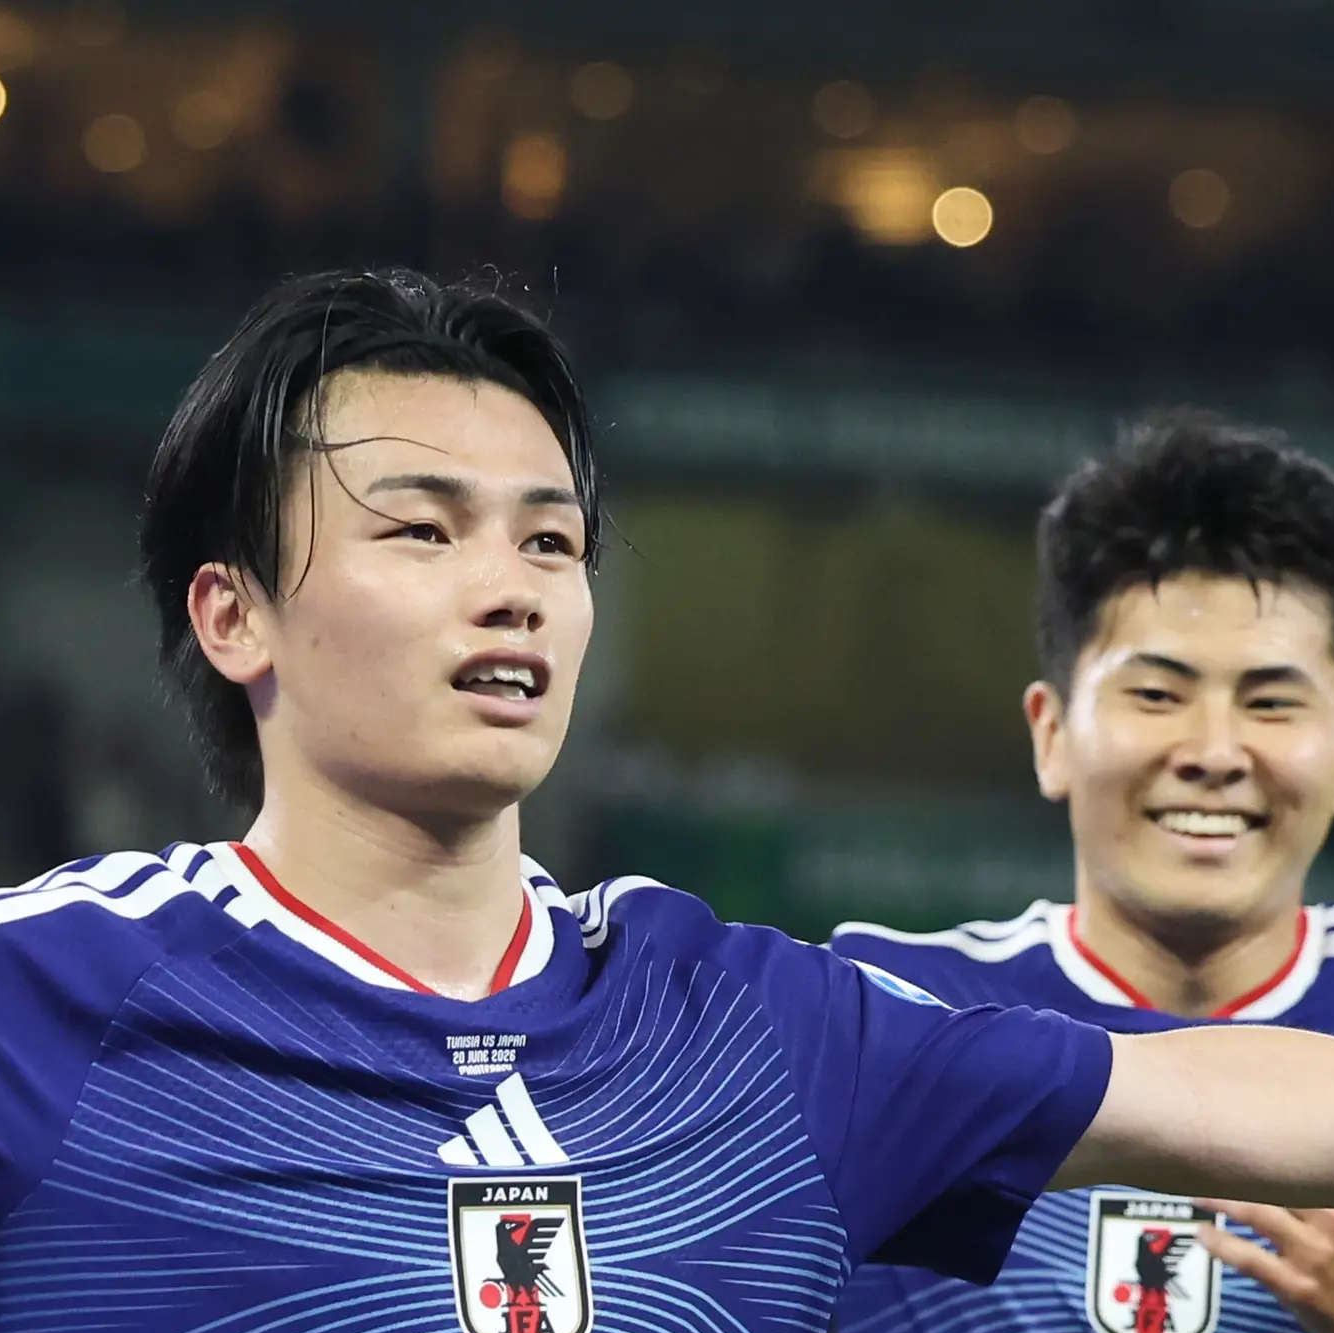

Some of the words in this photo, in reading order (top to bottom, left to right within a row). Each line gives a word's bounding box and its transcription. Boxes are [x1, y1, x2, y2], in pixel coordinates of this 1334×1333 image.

[446, 1035, 480, 1049] TUNISIA
[497, 1034, 526, 1047] JAPAN
[452, 1051, 465, 1064] 20
[467, 1050, 489, 1063] JUNE
[491, 1049, 516, 1062] 2026
[482, 1186, 548, 1202] JAPAN
[1123, 1200, 1194, 1219] JAPAN
[1125, 1308, 1177, 1333] JFA
